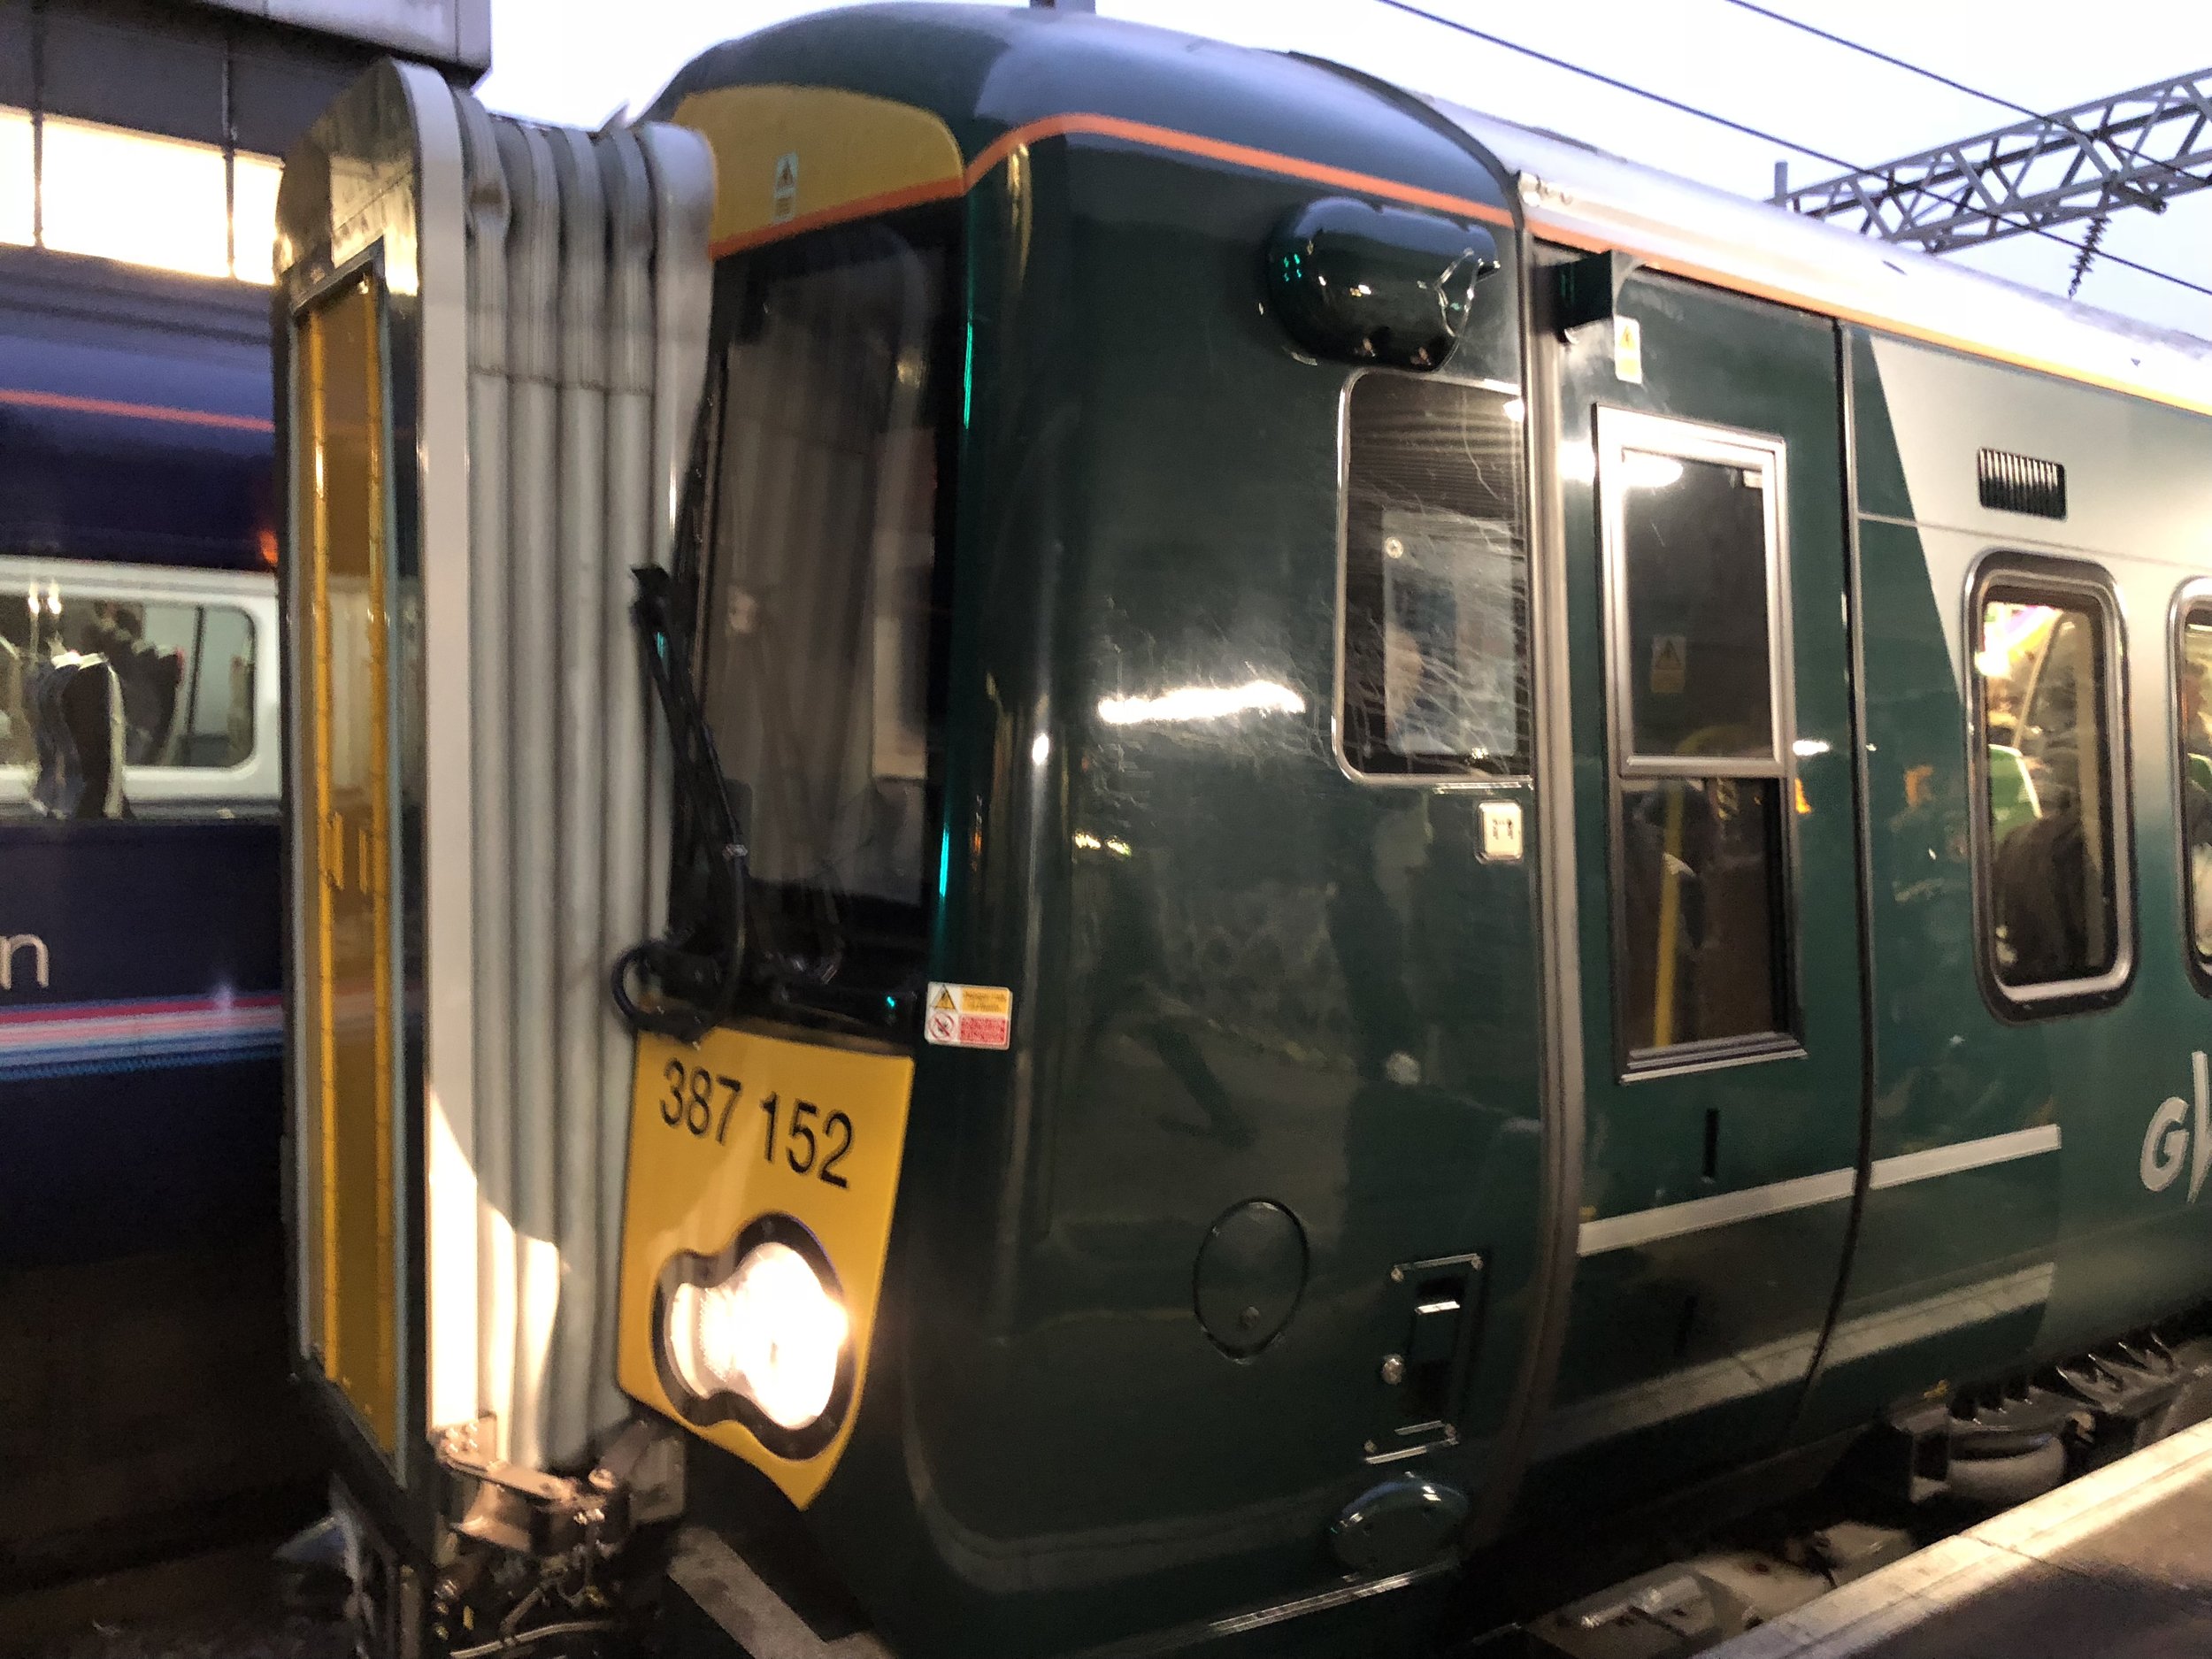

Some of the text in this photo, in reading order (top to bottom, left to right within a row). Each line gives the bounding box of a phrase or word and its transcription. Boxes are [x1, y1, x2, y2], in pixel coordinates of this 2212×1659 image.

[659, 1056, 855, 1190] 387 152
[2139, 1050, 2212, 1204] G
